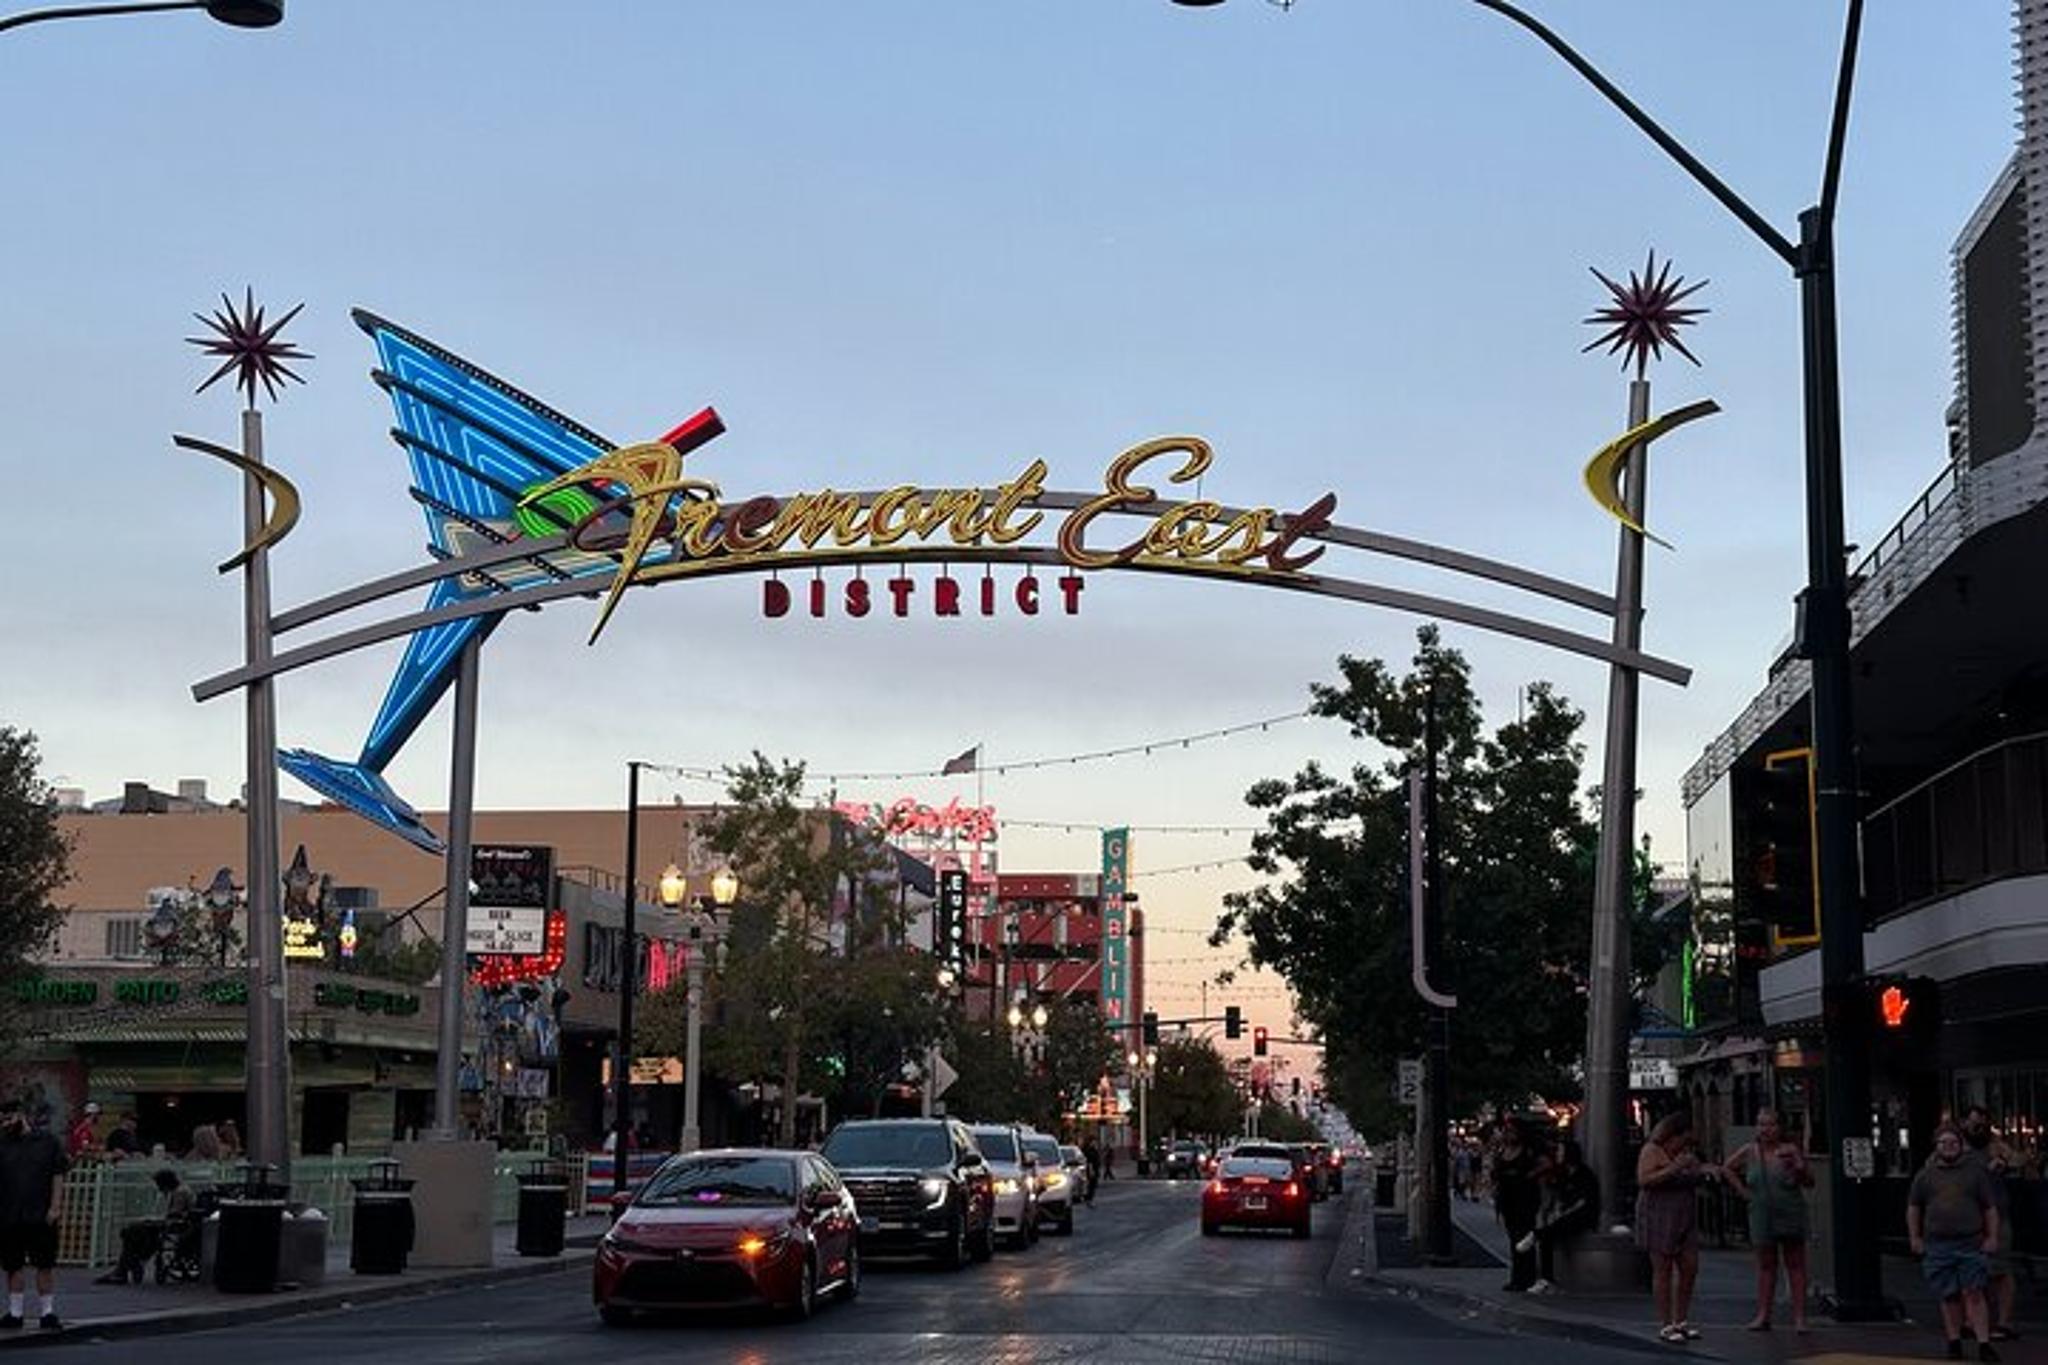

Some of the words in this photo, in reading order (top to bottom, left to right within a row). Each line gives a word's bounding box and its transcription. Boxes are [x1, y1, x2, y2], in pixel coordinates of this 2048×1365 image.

[516, 441, 1049, 646] Fremont
[1058, 436, 1338, 571] East
[764, 577, 1085, 618] DISTRICT
